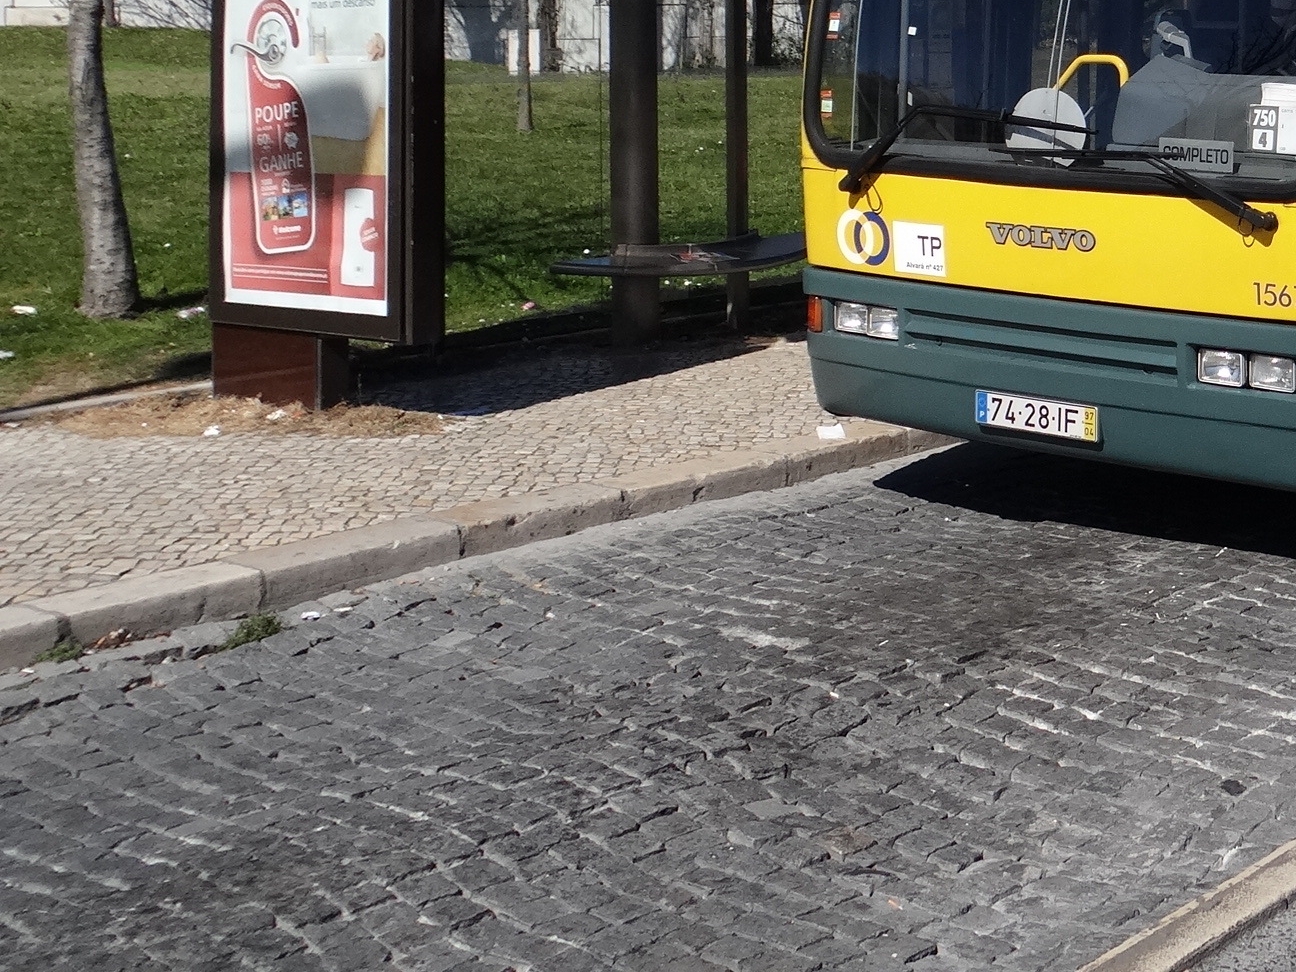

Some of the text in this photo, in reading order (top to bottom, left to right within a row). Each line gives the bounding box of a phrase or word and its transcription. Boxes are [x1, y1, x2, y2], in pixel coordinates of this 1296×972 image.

[329, 0, 341, 9] um
[254, 101, 300, 125] POUPE
[1252, 109, 1277, 127] 750
[1258, 132, 1268, 148] 4
[260, 151, 304, 173] GANHE
[1162, 145, 1229, 165] COMPLETO
[917, 235, 942, 257] TP
[985, 221, 1097, 253] VOLVO
[1084, 411, 1094, 421] 97
[1084, 426, 1094, 437] 04
